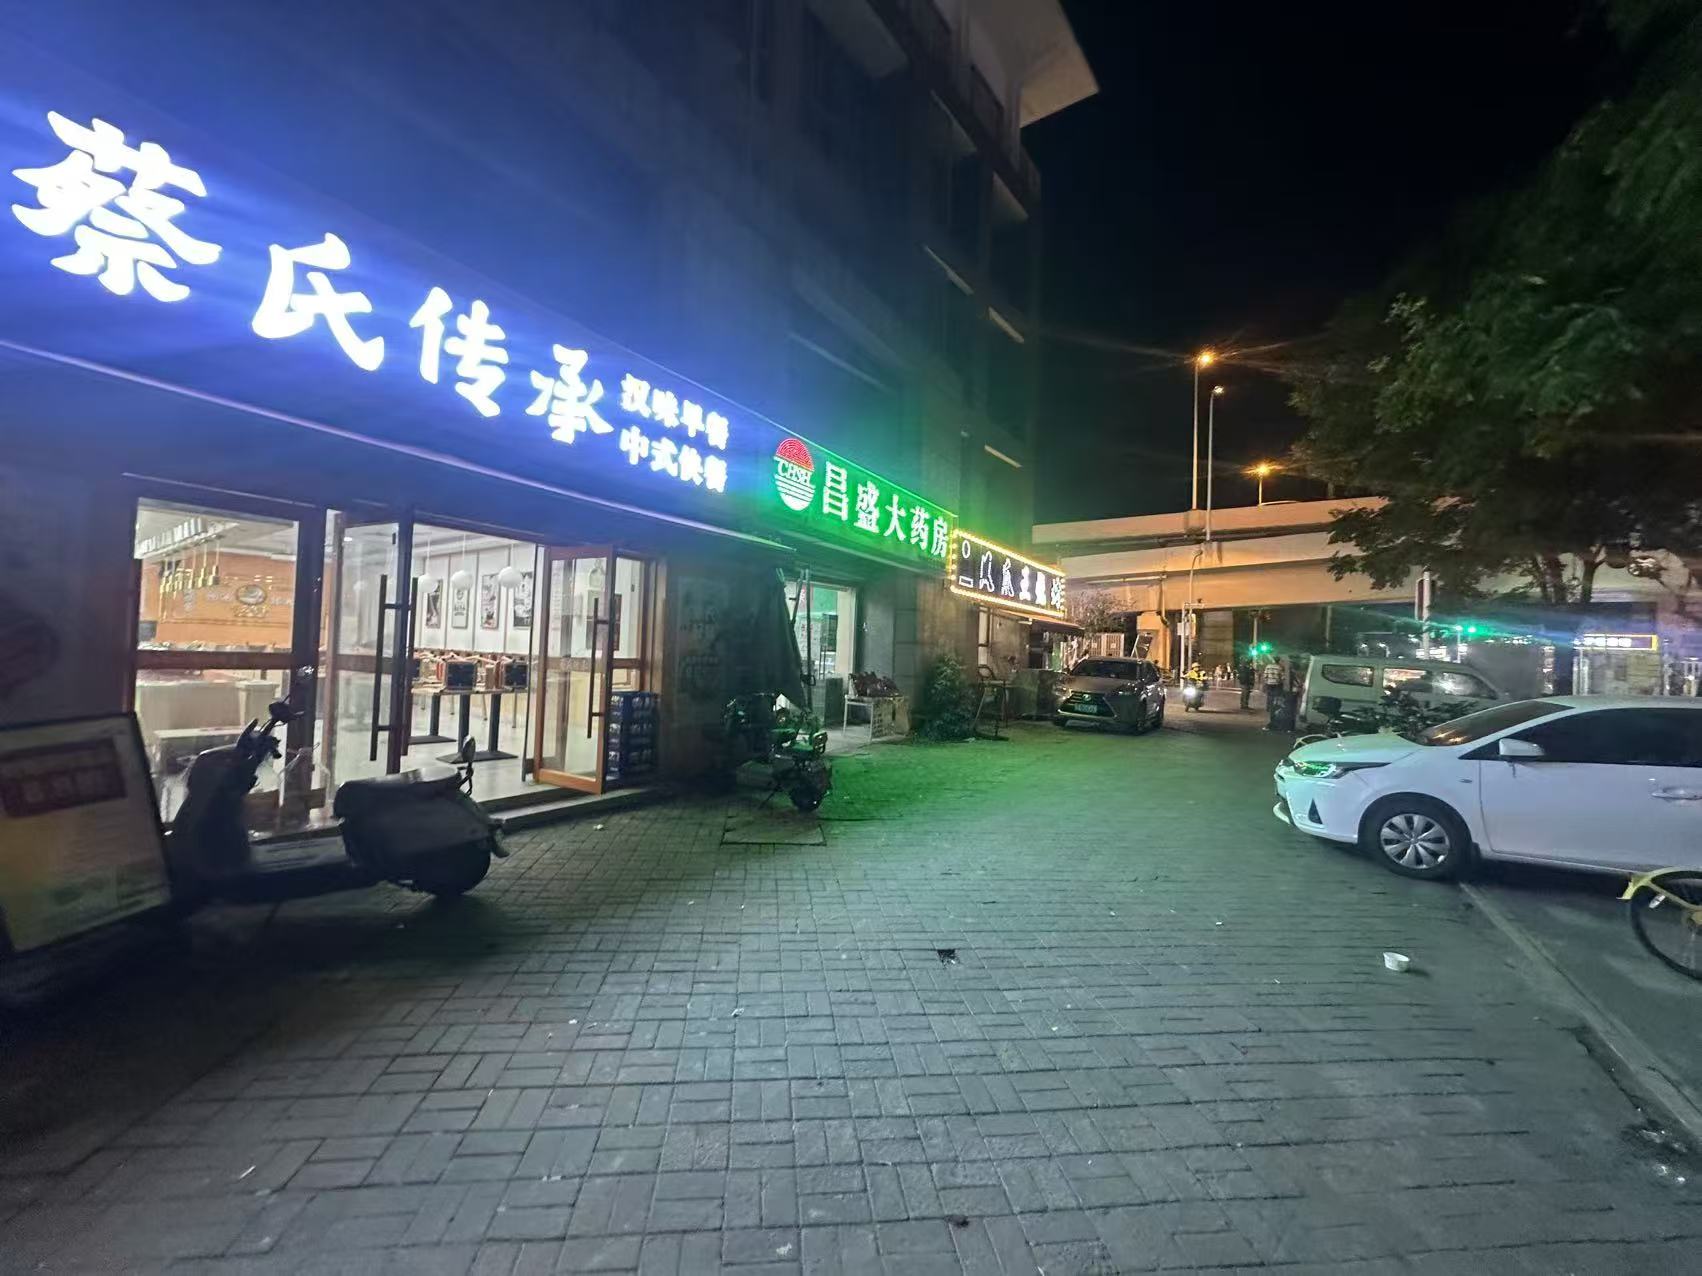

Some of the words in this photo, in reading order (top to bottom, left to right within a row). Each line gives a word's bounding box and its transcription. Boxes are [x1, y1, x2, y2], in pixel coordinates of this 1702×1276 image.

[11, 110, 614, 445] 蔡氏传承
[618, 425, 729, 494] 中式快餐
[821, 460, 950, 558] 昌盛大药房
